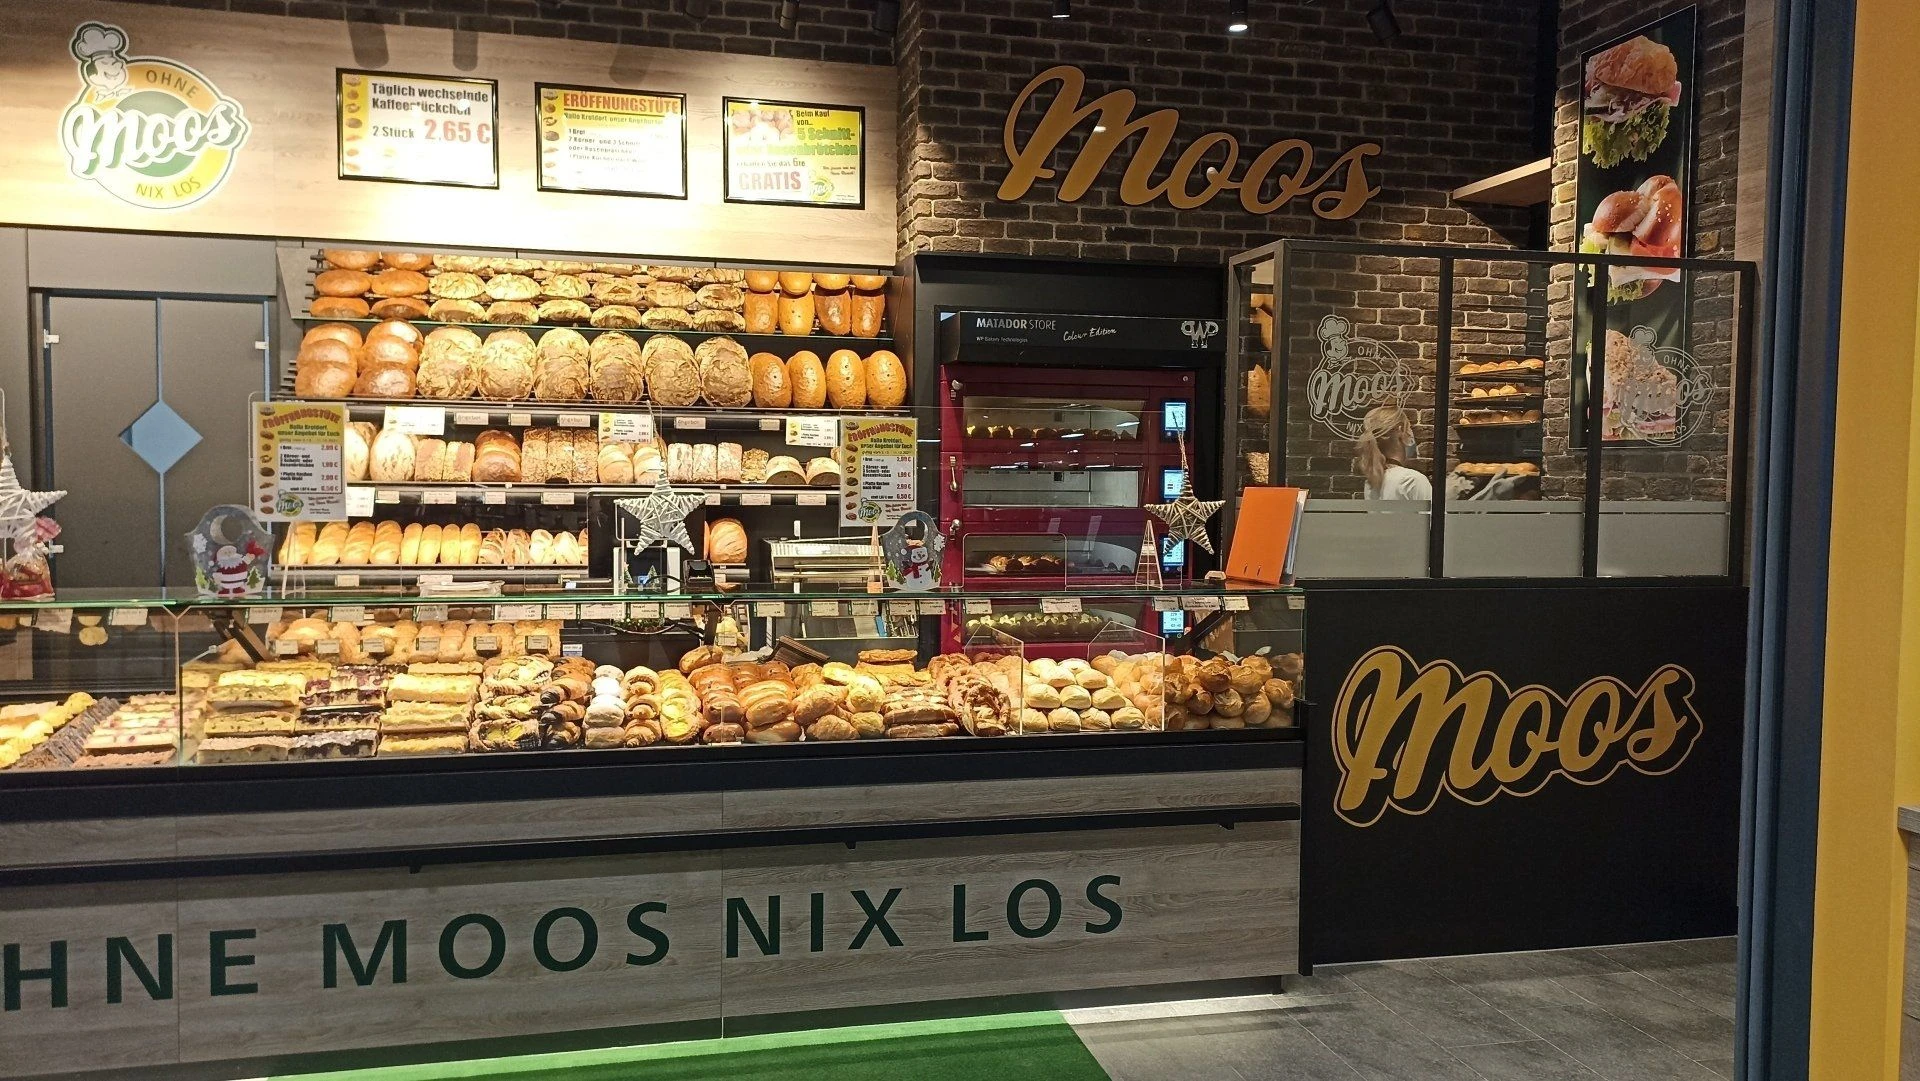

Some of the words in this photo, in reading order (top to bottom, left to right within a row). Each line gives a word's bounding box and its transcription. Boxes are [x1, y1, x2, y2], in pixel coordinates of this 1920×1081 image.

[145, 69, 198, 98] OHNE
[372, 82, 415, 96] Täglich
[418, 86, 488, 102] wechselnde
[372, 98, 471, 115] Kaffeeückchn
[564, 92, 679, 114] ERÖFFNUNGSTÜTE
[62, 103, 239, 176] Moos
[372, 126, 379, 136] 2
[382, 127, 415, 139] Stück
[477, 123, 491, 144] €
[996, 65, 1382, 220] Moos
[136, 183, 164, 199] NIX
[173, 177, 201, 197] LOS
[739, 170, 802, 191] GRATIS
[976, 317, 1027, 329] MATADOR
[1028, 319, 1056, 331] STORE
[1089, 326, 1118, 338] Edition
[1357, 345, 1387, 365] OHNE
[1663, 355, 1690, 373] OHNE
[1310, 370, 1407, 415] Moos
[1346, 421, 1364, 434] NIX
[1336, 650, 1688, 812] Moos
[323, 901, 670, 989] MOOS
[726, 887, 904, 958] NIX
[953, 874, 1123, 943] LOS
